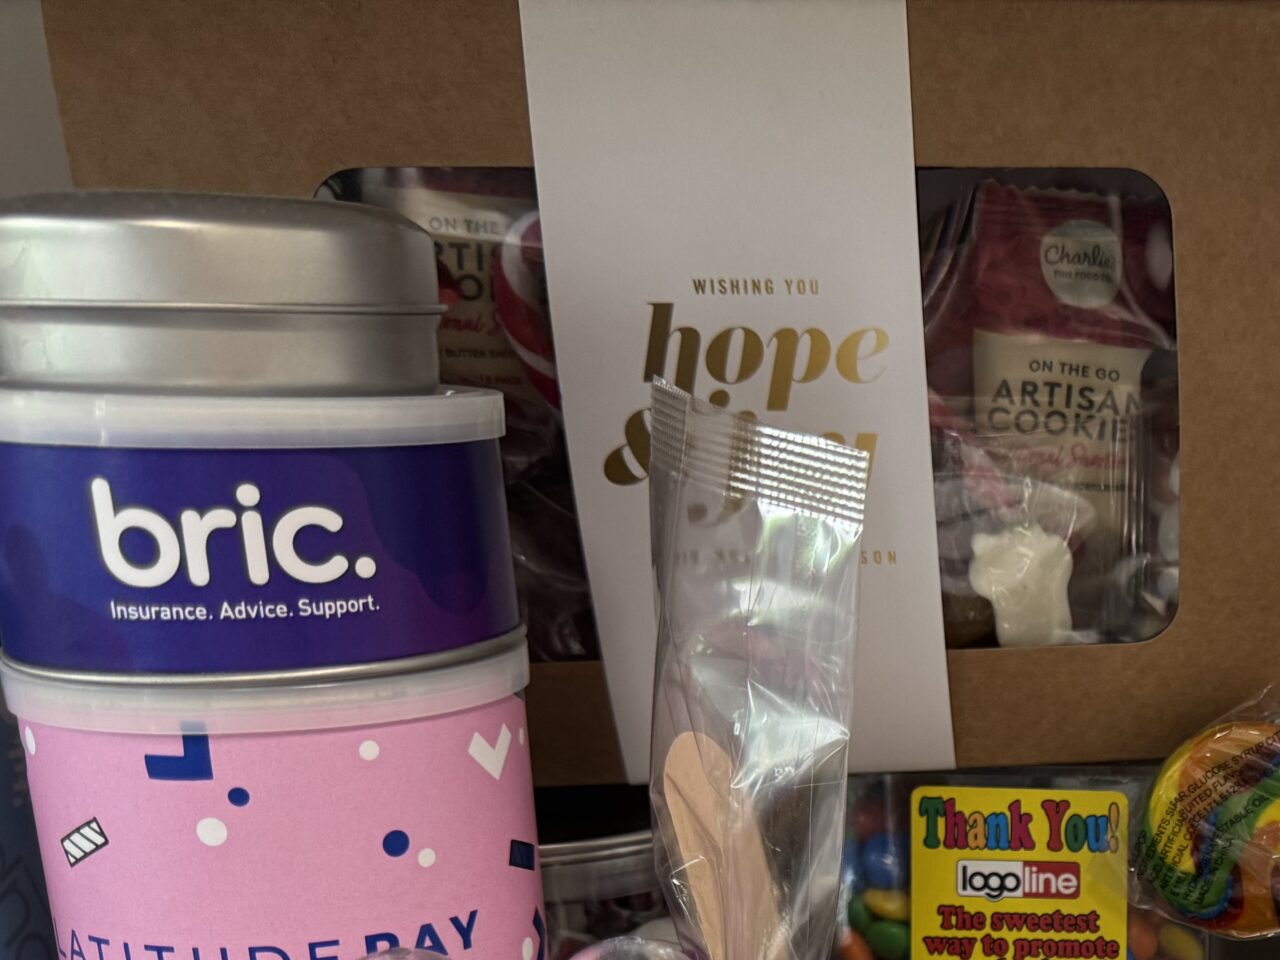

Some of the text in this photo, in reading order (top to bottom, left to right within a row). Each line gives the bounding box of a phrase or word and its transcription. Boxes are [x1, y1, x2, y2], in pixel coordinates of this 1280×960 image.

[692, 278, 820, 296] WISHING YOU
[643, 302, 890, 411] hope
[1029, 360, 1120, 383] ON THE GO
[91, 477, 377, 588] bric.
[110, 594, 381, 621] Insurance. Advice. Support.
[919, 796, 1036, 852] Thank
[1041, 799, 1120, 854] You!
[937, 904, 1101, 933] The sweetest
[981, 933, 1009, 957] to
